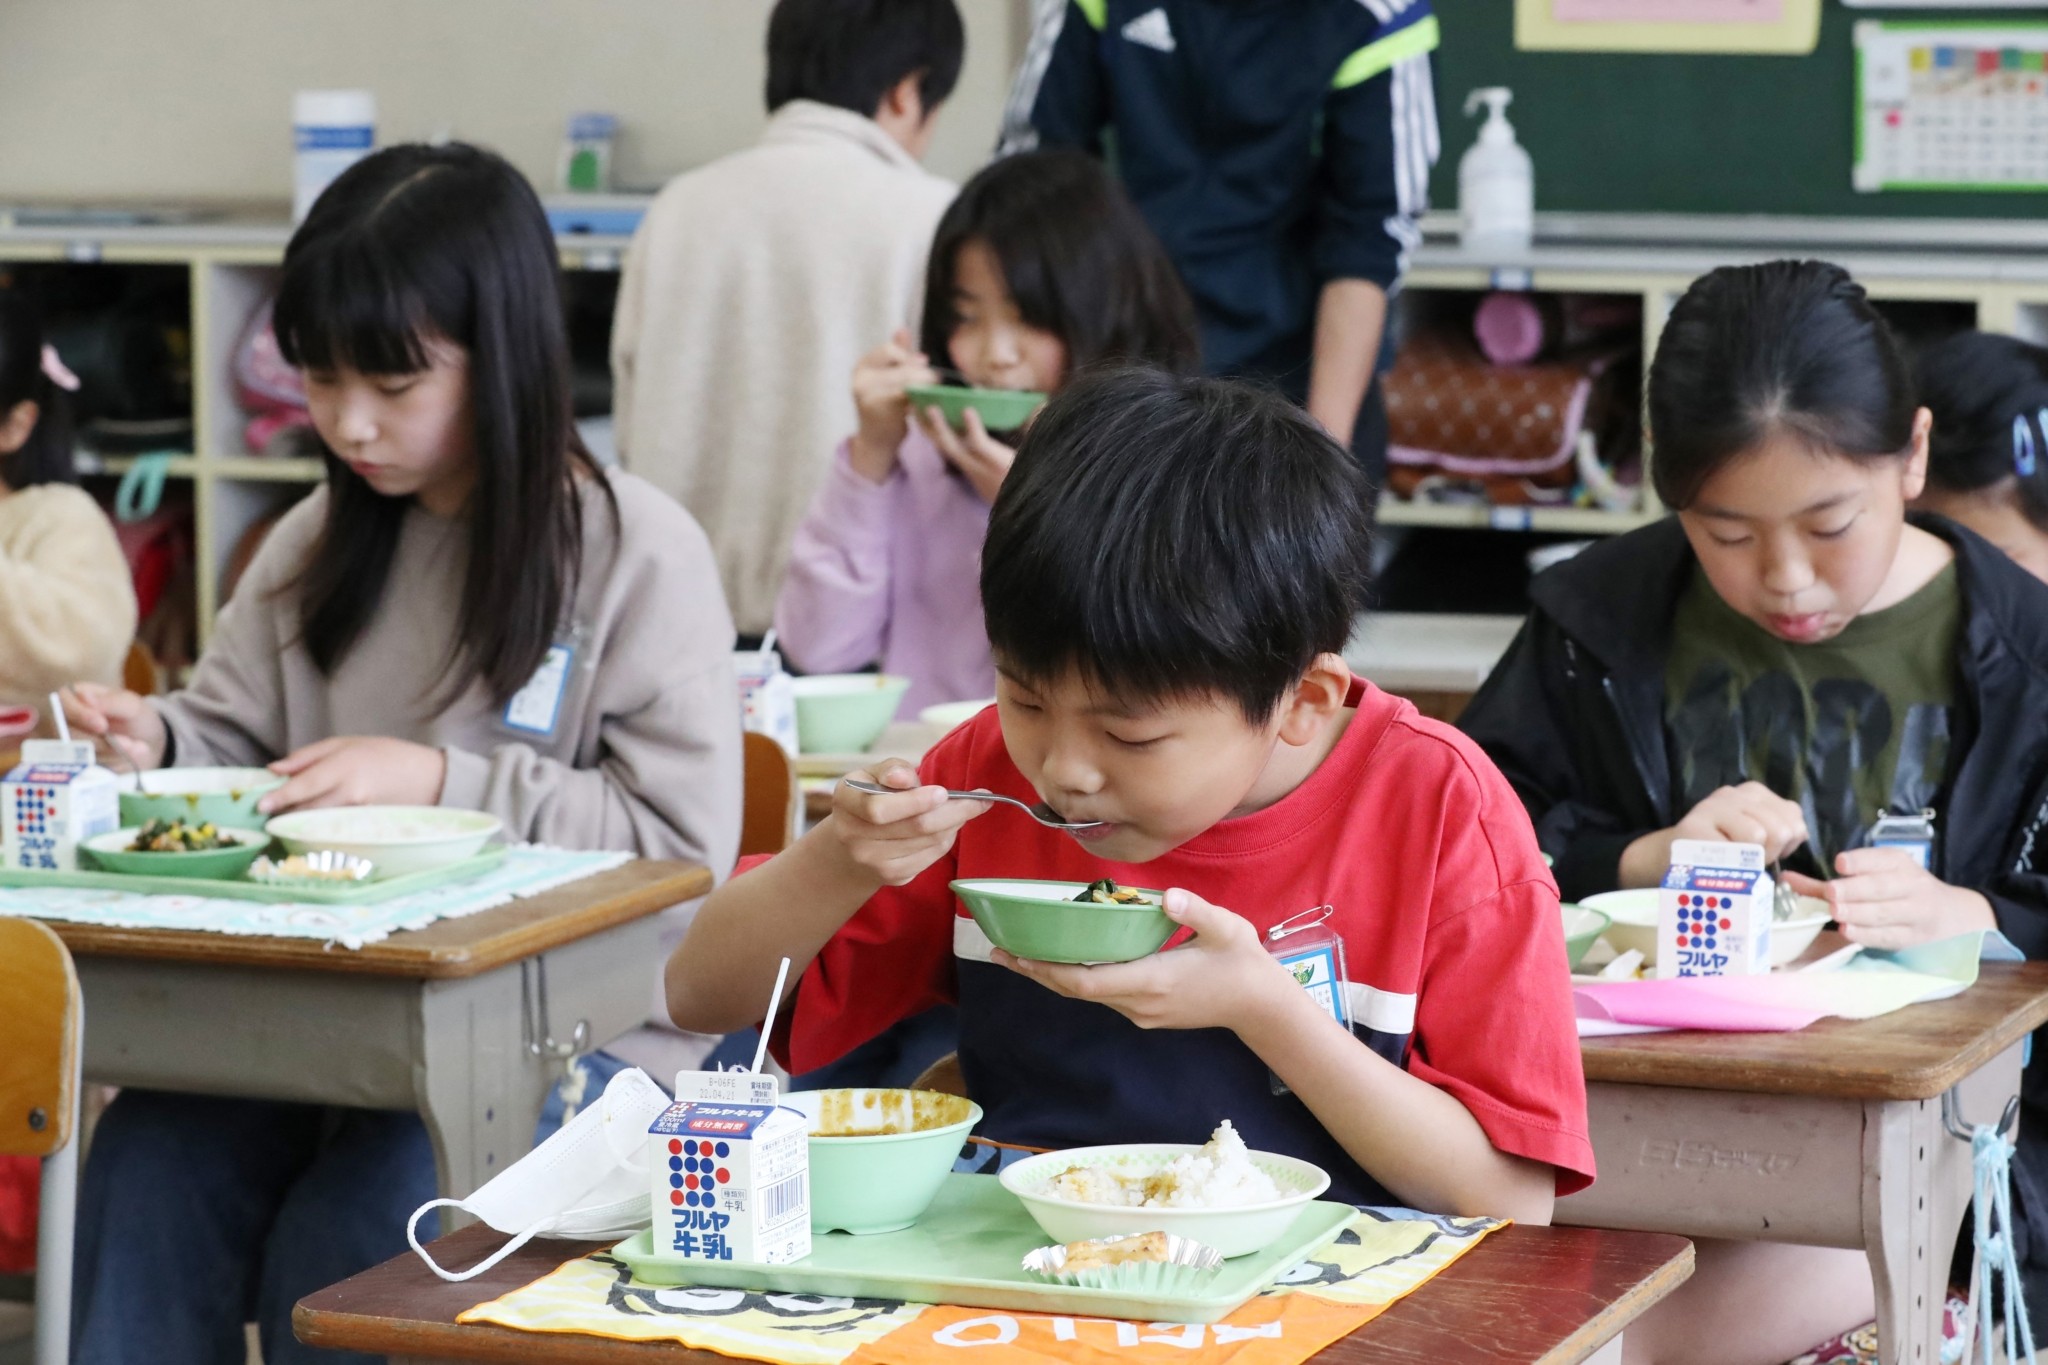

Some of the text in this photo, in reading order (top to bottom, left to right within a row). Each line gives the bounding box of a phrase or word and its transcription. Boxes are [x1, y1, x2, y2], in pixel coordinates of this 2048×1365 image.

[1677, 951, 1728, 968] フルヤ
[696, 1107, 764, 1118] フルヤ牛乳
[692, 1120, 745, 1131] 成分無調整
[724, 1200, 746, 1212] 牛乳
[671, 1208, 731, 1232] フルヤ
[673, 1229, 733, 1261] 牛乳
